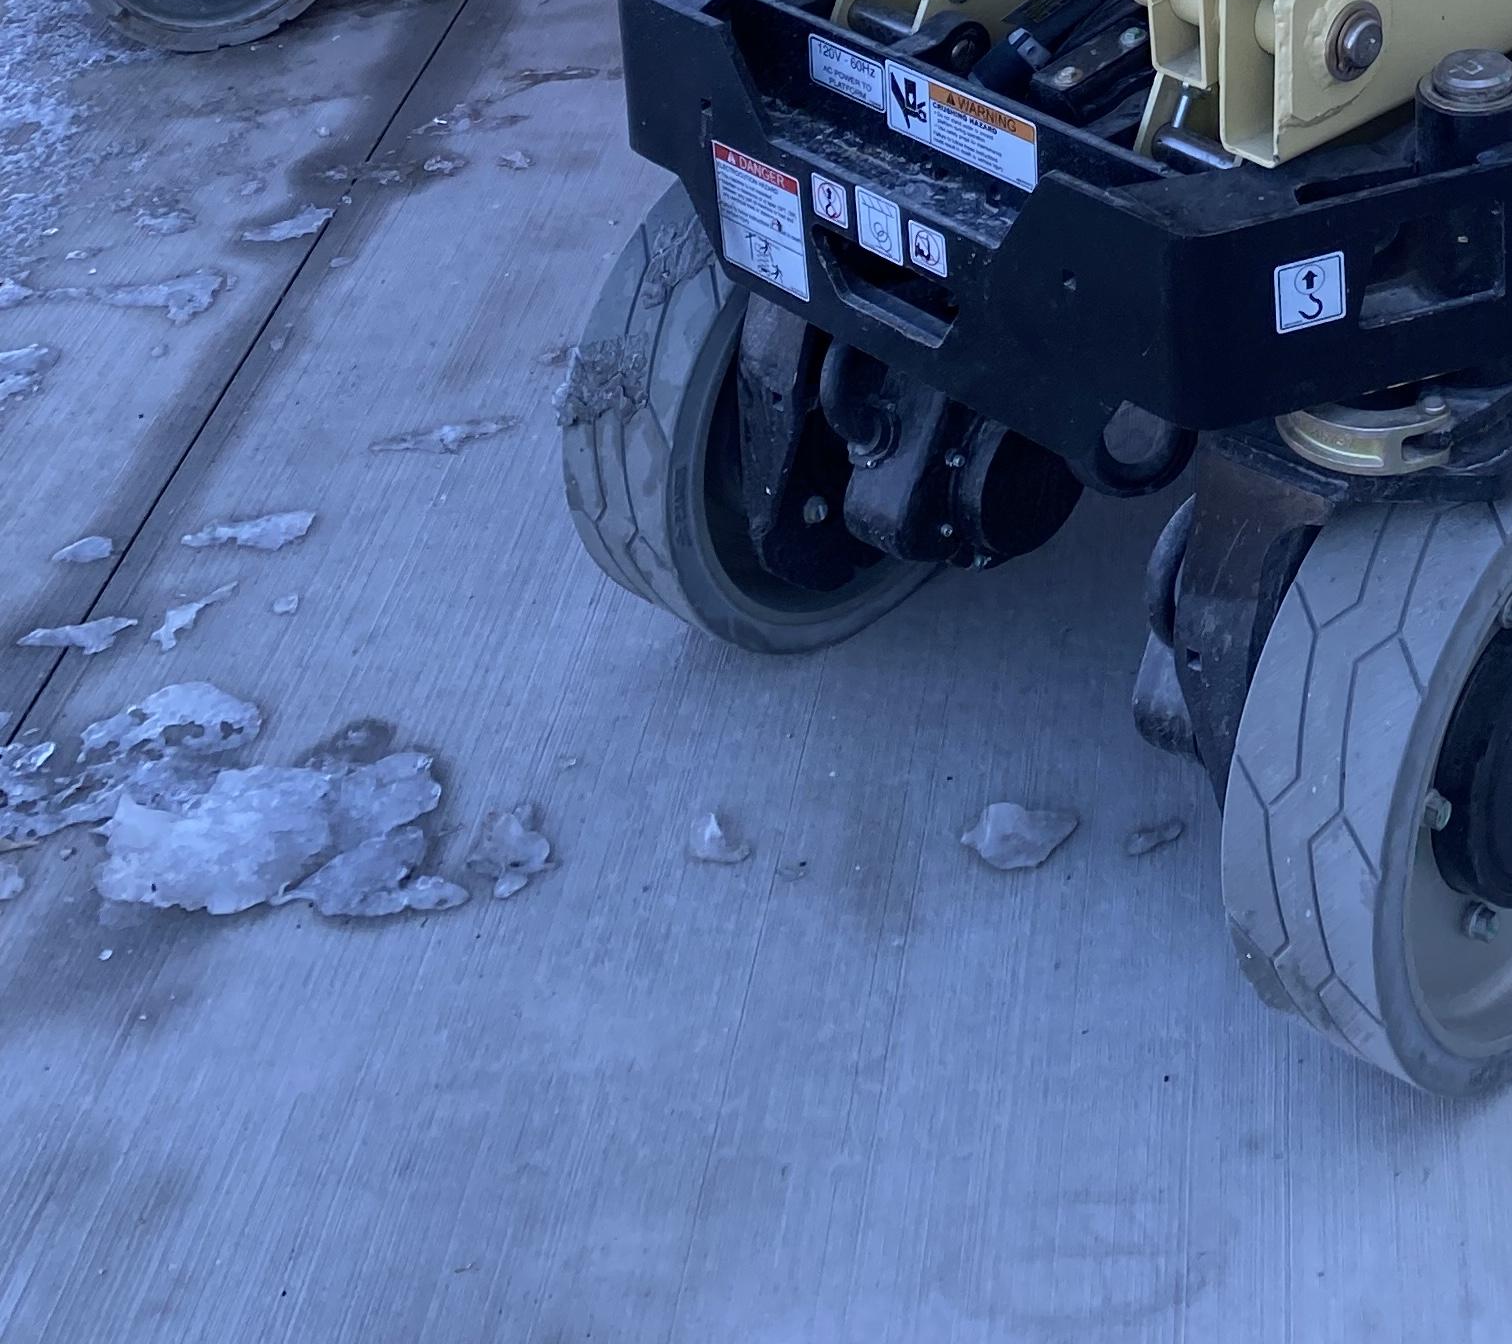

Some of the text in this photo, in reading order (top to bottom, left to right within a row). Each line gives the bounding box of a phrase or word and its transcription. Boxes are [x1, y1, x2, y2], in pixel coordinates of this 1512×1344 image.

[817, 42, 842, 62] 120V
[850, 57, 876, 79] 60Hz
[957, 96, 1018, 133] WARNING
[738, 154, 785, 189] DANGER
